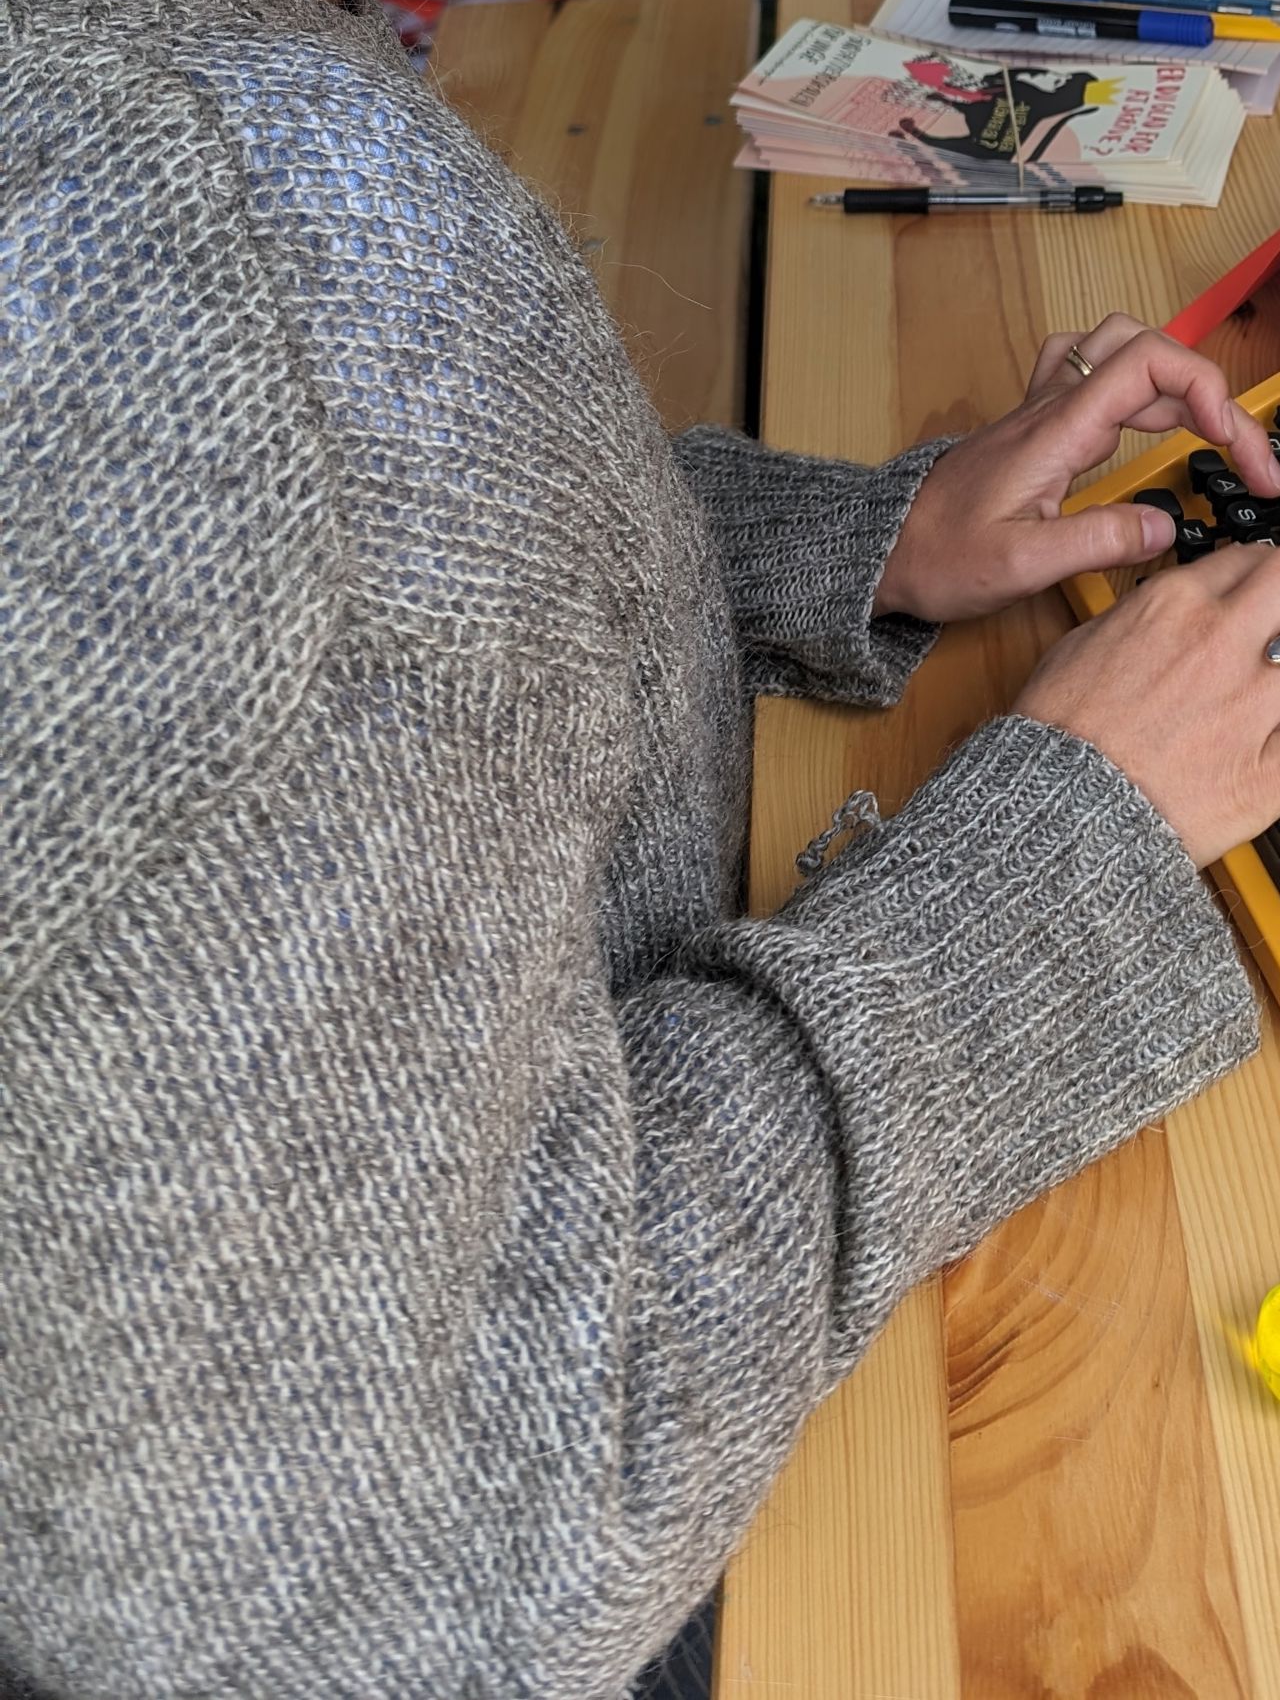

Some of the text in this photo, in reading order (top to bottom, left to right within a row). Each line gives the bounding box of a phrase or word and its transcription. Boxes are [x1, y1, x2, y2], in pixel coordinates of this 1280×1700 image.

[1217, 478, 1236, 491] A
[1238, 508, 1256, 521] S
[1183, 527, 1203, 539] Z
